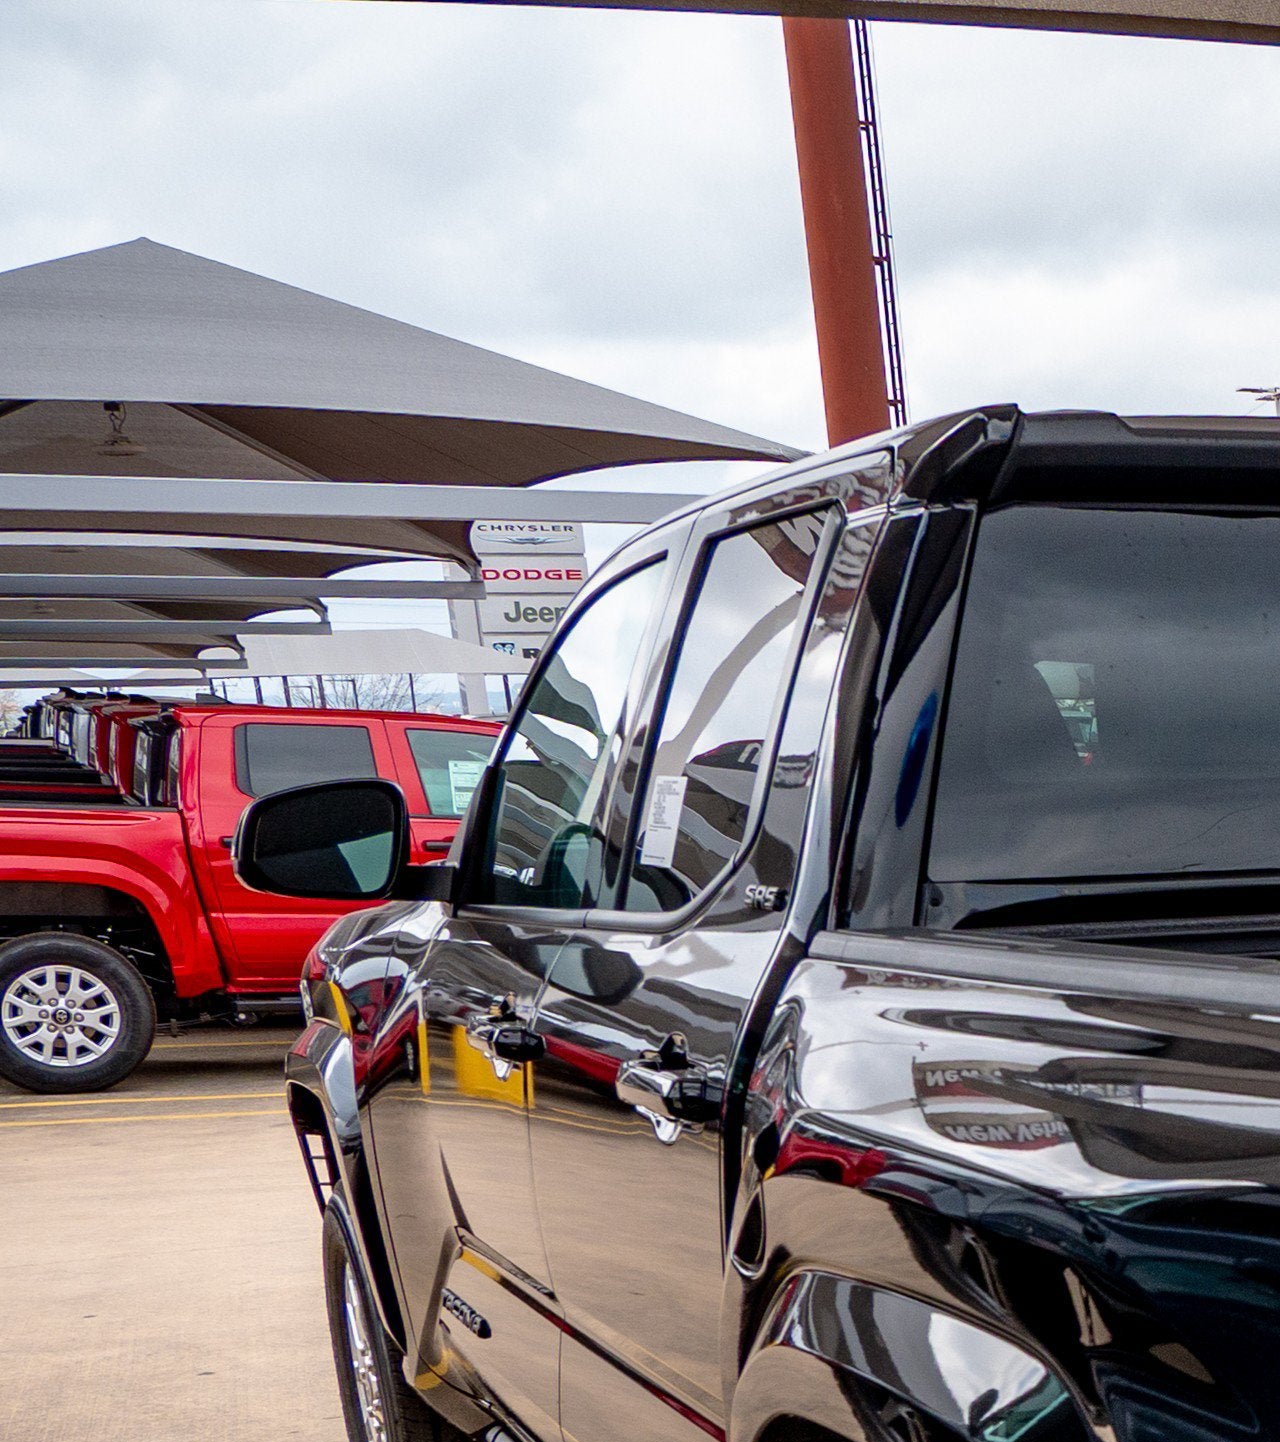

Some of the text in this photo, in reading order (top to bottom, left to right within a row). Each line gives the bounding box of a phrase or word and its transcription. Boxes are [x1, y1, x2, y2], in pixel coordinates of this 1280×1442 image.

[477, 524, 574, 532] CHRYSLER
[481, 569, 583, 581] DODGE
[744, 884, 778, 910] SR5
